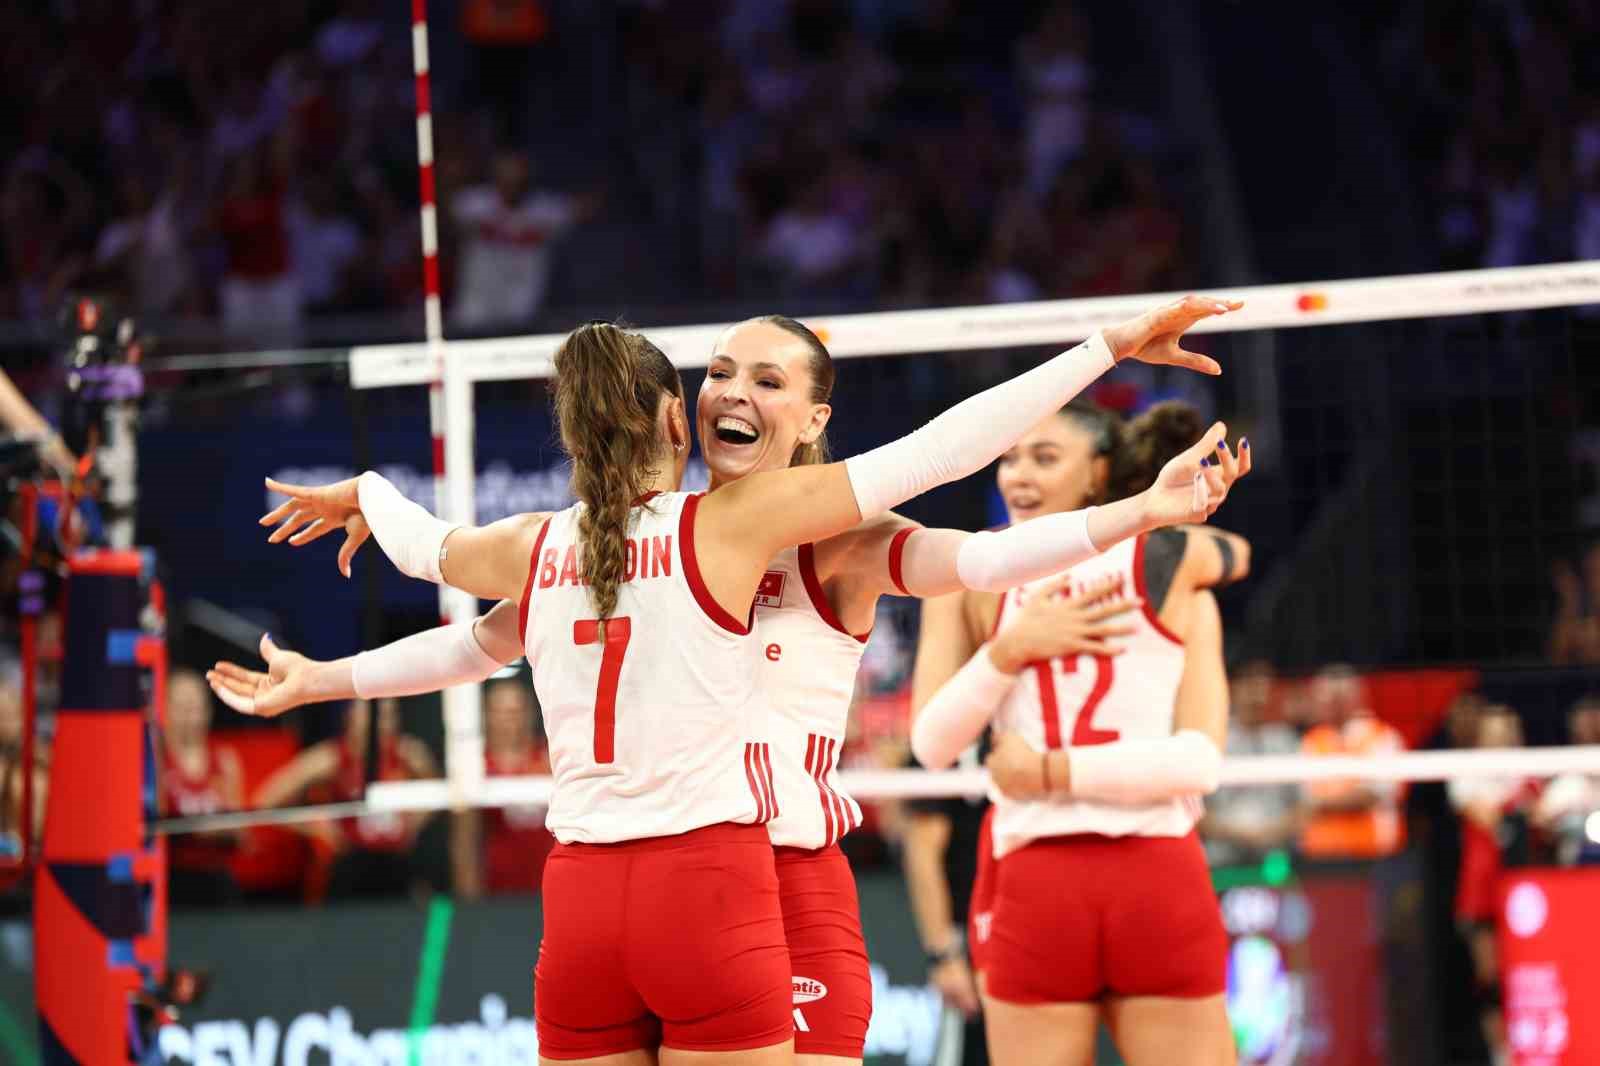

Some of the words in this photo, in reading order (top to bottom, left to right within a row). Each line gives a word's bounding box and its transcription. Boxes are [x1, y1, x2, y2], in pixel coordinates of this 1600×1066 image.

[539, 535, 672, 589] BADIN
[574, 616, 631, 764] 7
[1027, 645, 1120, 750] 12
[792, 981, 821, 993] atis
